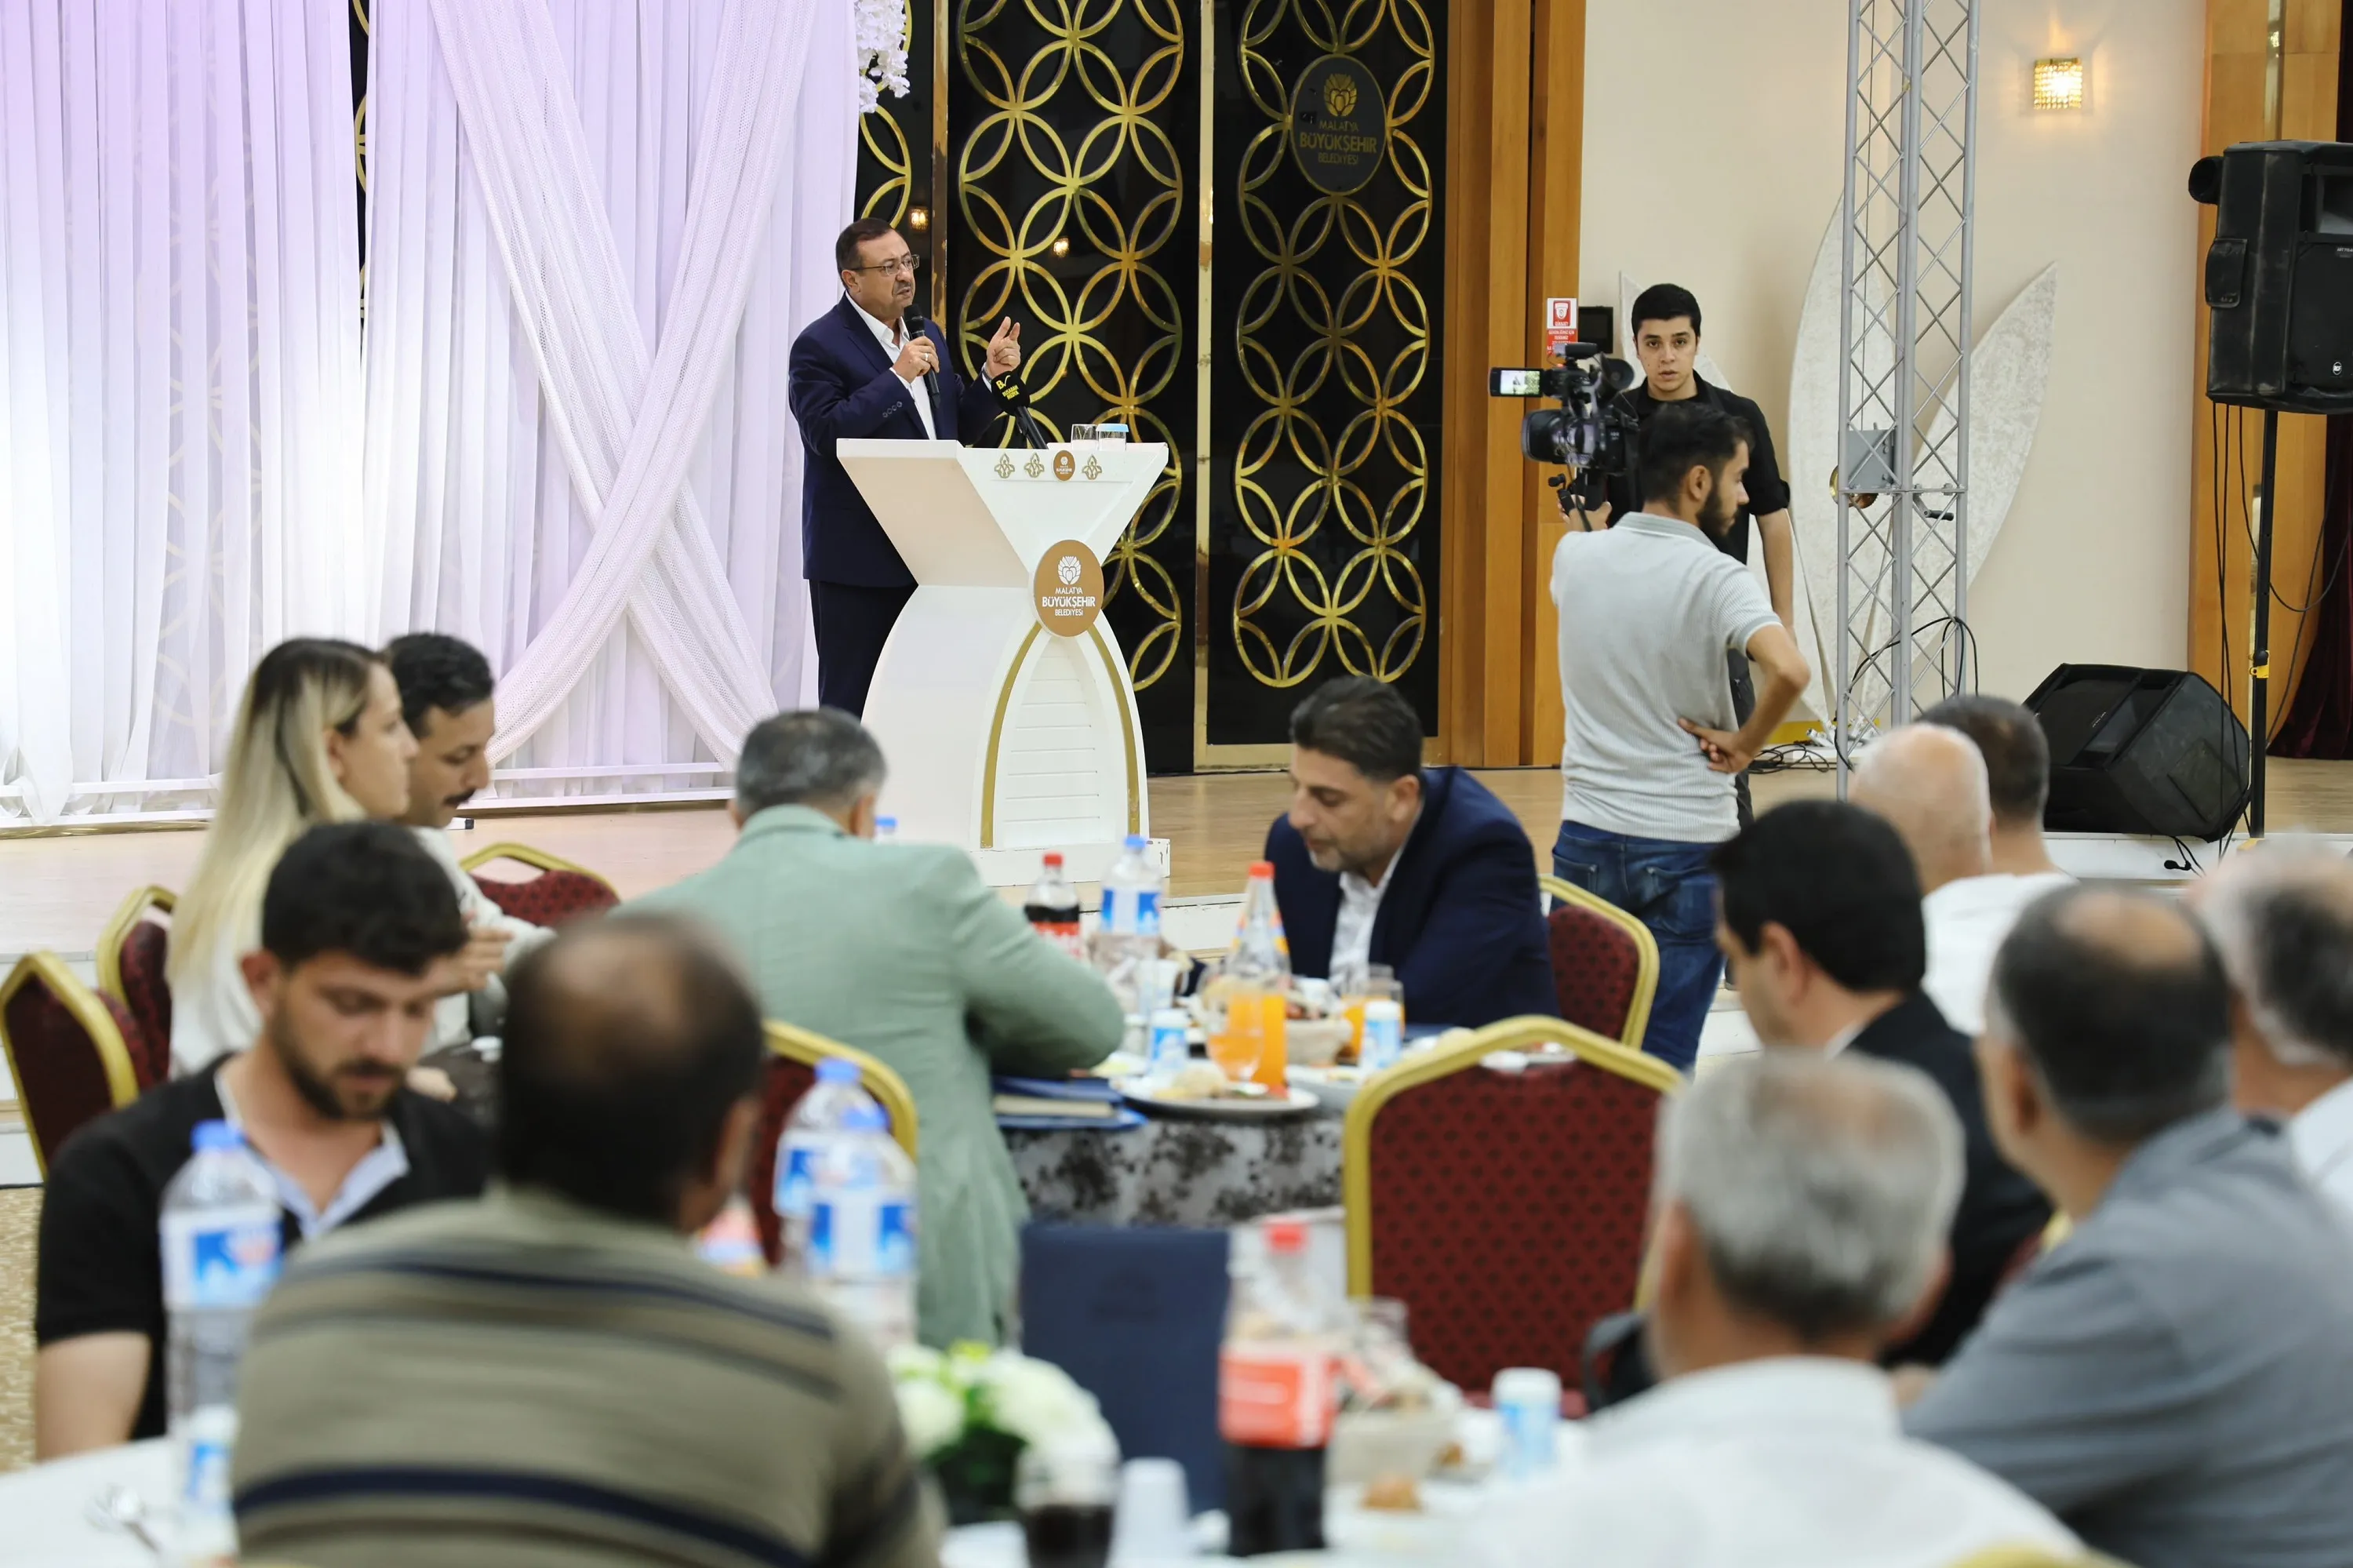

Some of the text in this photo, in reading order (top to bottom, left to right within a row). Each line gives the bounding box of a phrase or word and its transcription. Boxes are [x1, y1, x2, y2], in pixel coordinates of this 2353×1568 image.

[1319, 120, 1359, 133] MALATYA
[1042, 596, 1096, 608] BÜYÜKŞEHİR
[1055, 607, 1083, 616] BELEDİYESİ
